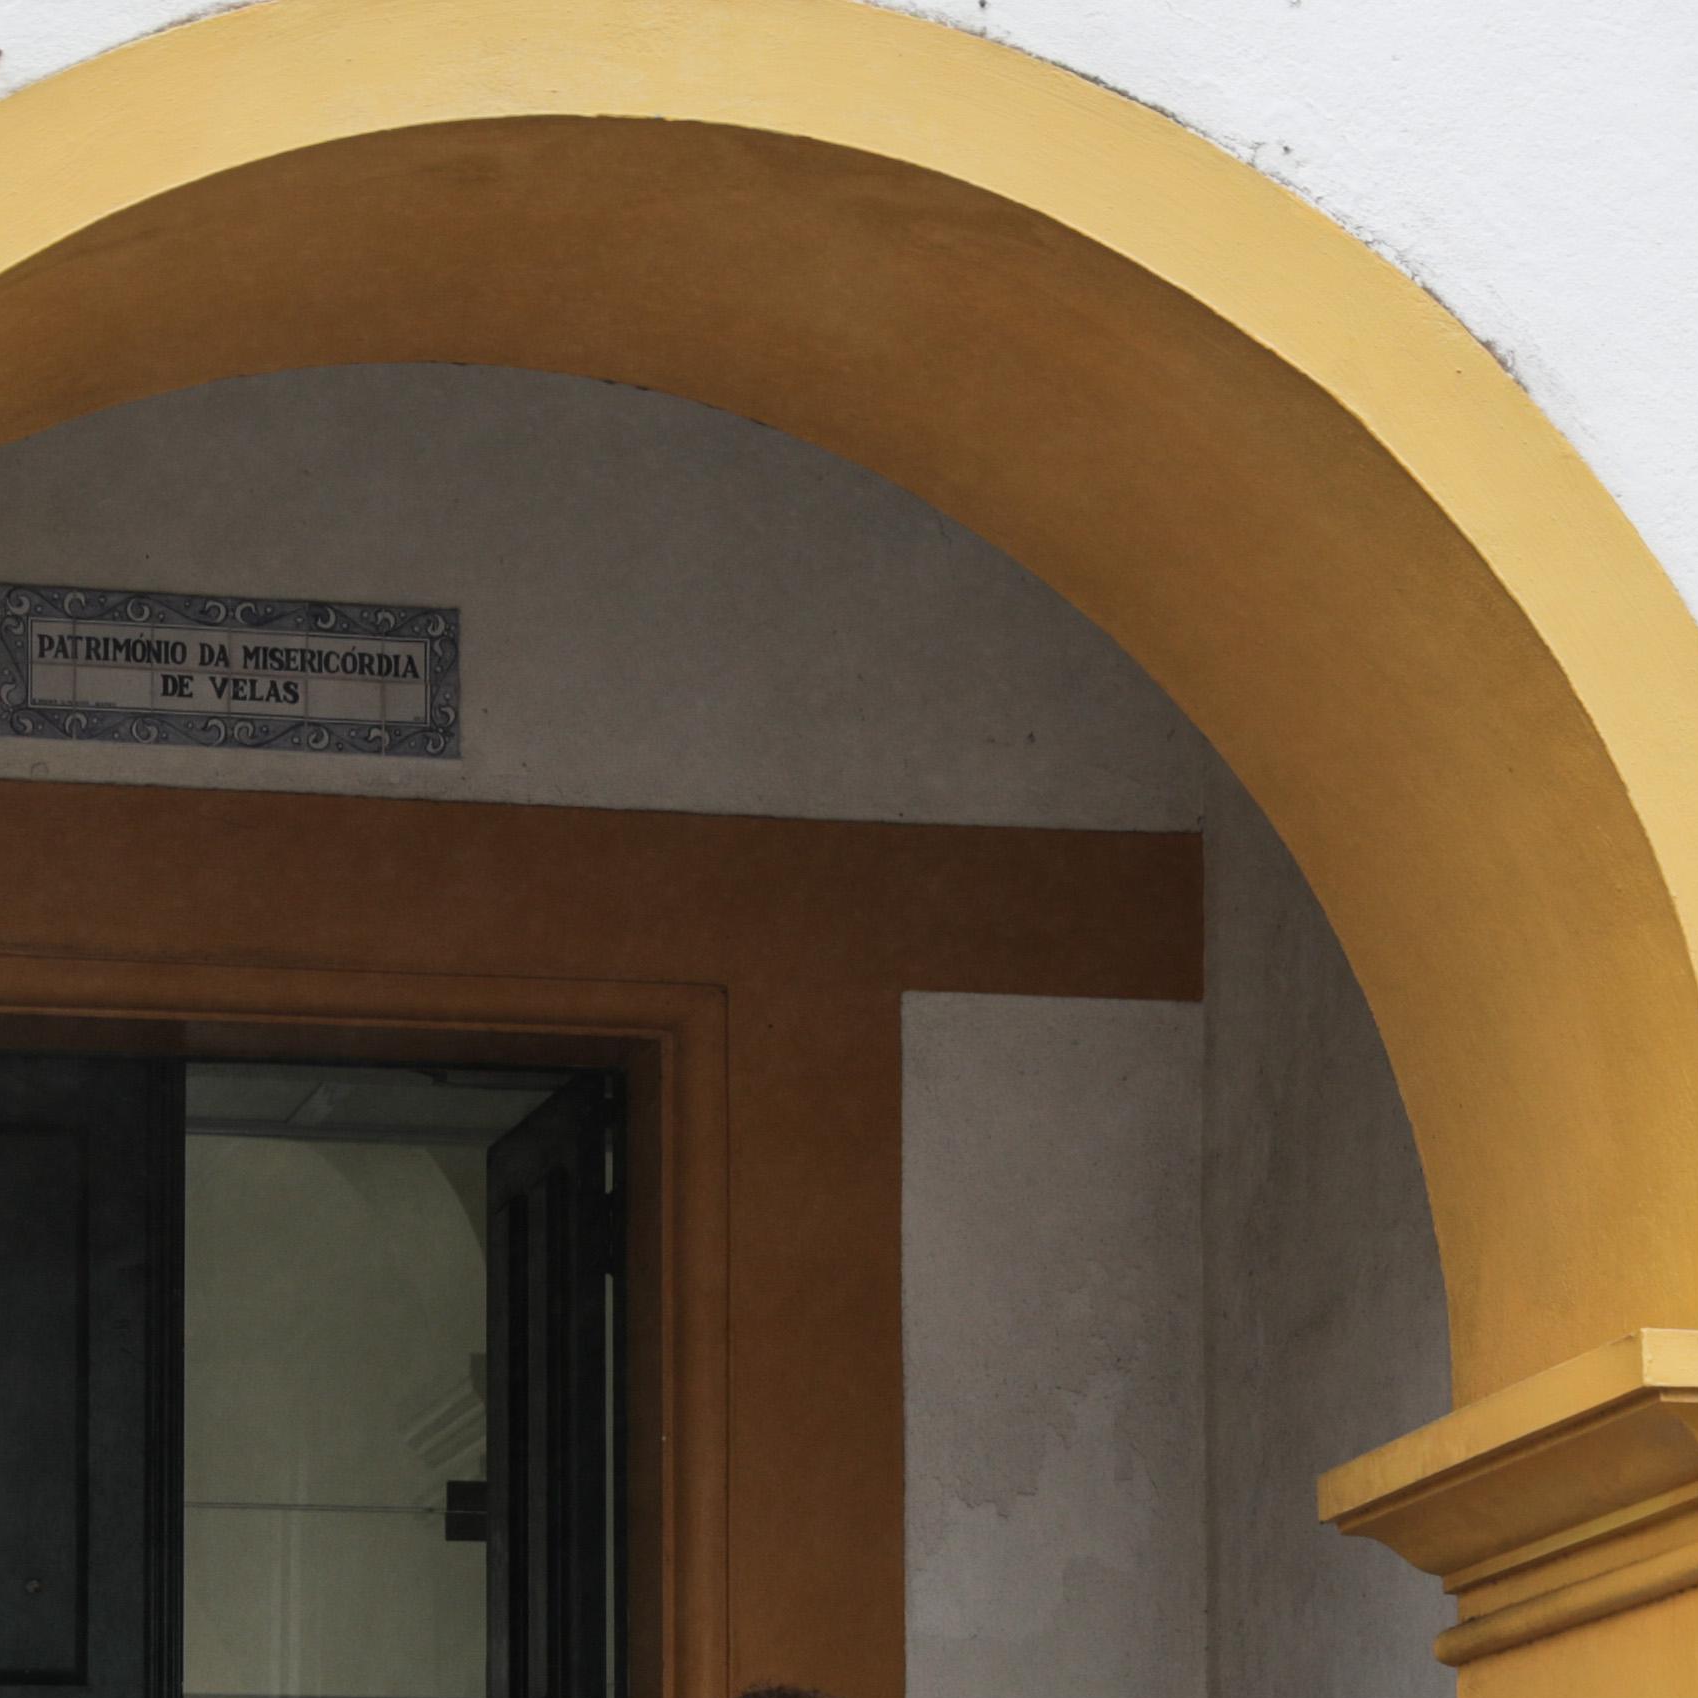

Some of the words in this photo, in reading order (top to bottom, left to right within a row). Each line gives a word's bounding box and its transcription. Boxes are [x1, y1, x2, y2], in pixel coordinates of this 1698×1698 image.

[37, 631, 187, 664] PATRIMÓNIO
[199, 642, 230, 668] DA
[242, 645, 420, 679] MISERICÓRDIA
[161, 674, 194, 698] DE
[209, 676, 299, 704] VELAS
